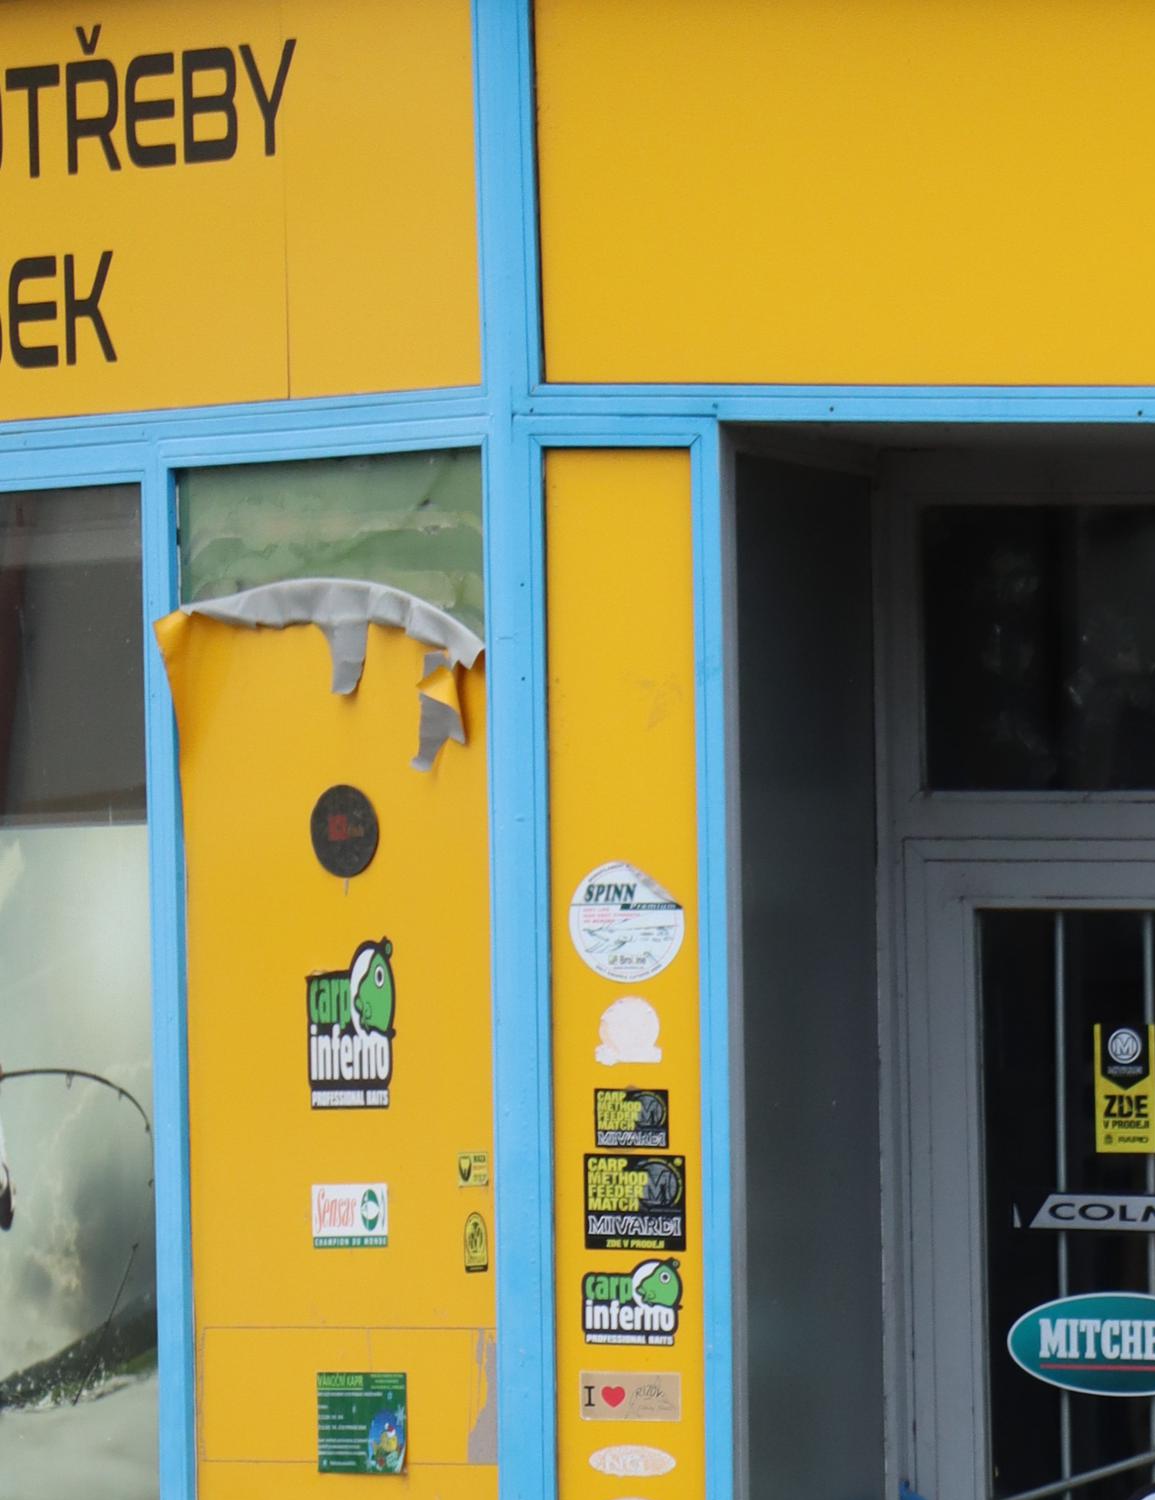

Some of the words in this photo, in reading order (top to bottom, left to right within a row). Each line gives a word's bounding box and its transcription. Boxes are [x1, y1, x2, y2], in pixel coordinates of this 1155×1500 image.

[0, 24, 297, 178] TŘEBY
[0, 250, 117, 369] EK
[584, 883, 638, 903] SPINN
[310, 978, 351, 1029] carp
[310, 1024, 389, 1081] inferno
[597, 1091, 627, 1102] CARP
[1103, 1094, 1148, 1118] ZDE
[598, 1120, 635, 1131] MATCH
[588, 1157, 628, 1171] CARP
[588, 1171, 649, 1185] METHOD
[588, 1185, 644, 1199] FEEDER
[315, 1188, 357, 1233] Sensas
[588, 1198, 639, 1212] MATCH
[588, 1215, 682, 1236] MIVARDI
[585, 1275, 634, 1305] carp
[585, 1299, 675, 1332] inferno
[584, 1385, 596, 1407] I
